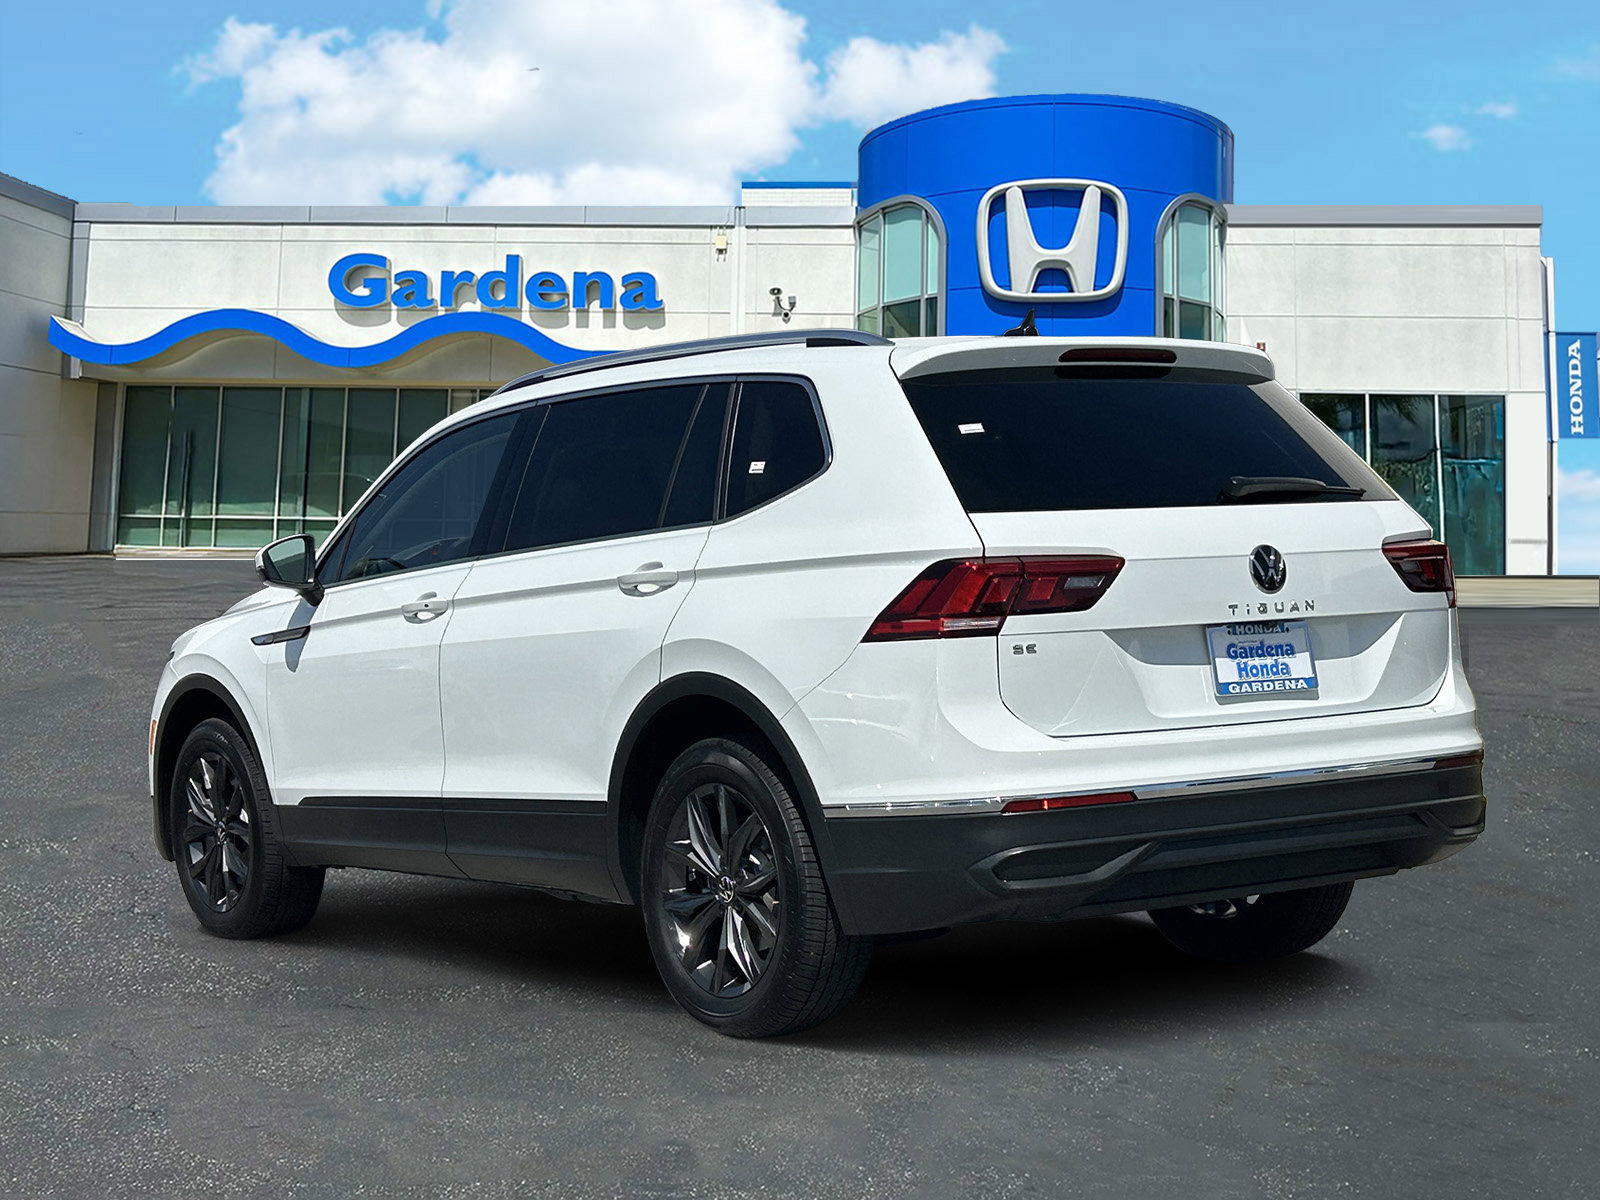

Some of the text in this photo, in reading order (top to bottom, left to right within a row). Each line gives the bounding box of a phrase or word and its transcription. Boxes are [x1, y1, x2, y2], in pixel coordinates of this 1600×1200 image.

[328, 252, 664, 311] Gardena
[1567, 339, 1584, 435] HONDA
[1012, 643, 1037, 655] SE
[1226, 640, 1296, 660] Gardena
[1236, 658, 1292, 679] Honda
[1228, 679, 1309, 694] GARDENA
